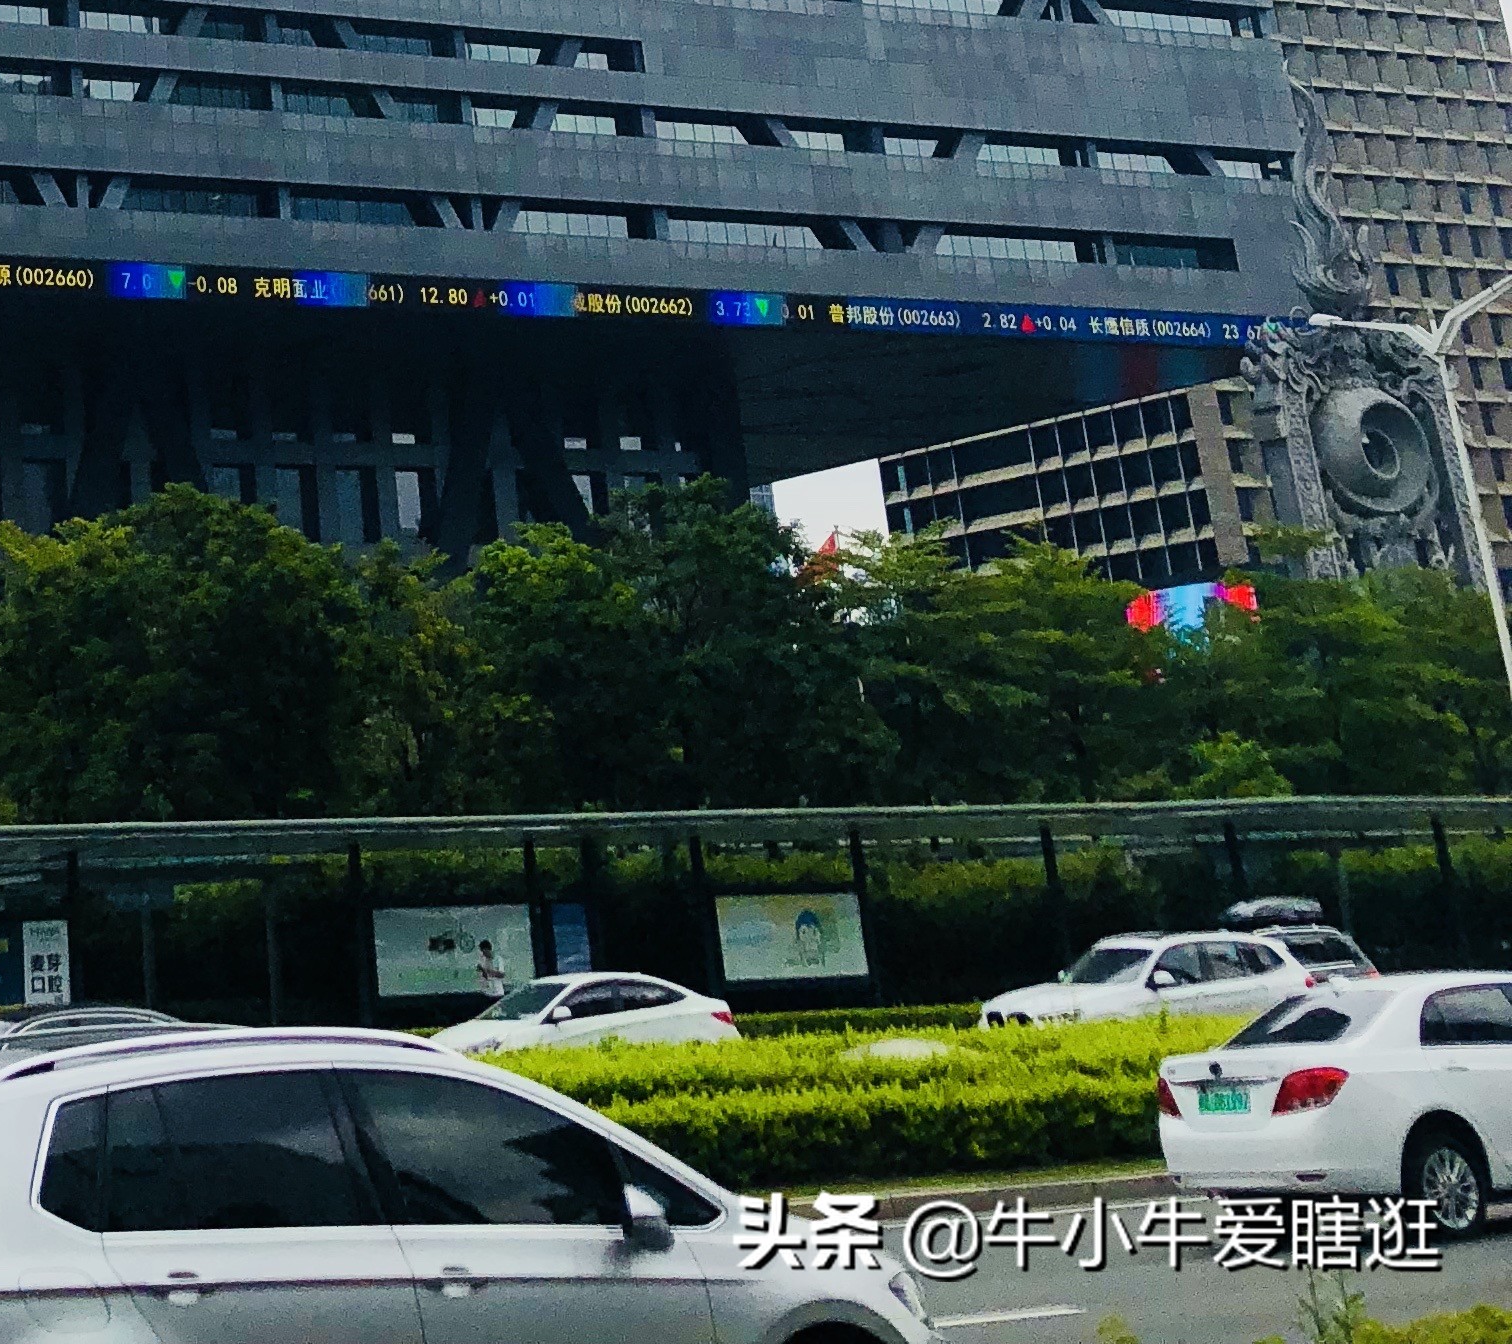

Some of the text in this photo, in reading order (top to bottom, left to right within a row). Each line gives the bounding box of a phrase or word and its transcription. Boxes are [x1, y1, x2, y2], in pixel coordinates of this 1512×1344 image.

[188, 275, 238, 294] -0.08
[420, 287, 468, 305] 12.80
[489, 290, 535, 308] +0.01
[829, 303, 960, 329] 普邦股份(002663)
[982, 312, 1018, 330] 2.82
[1035, 315, 1077, 332] +0.04
